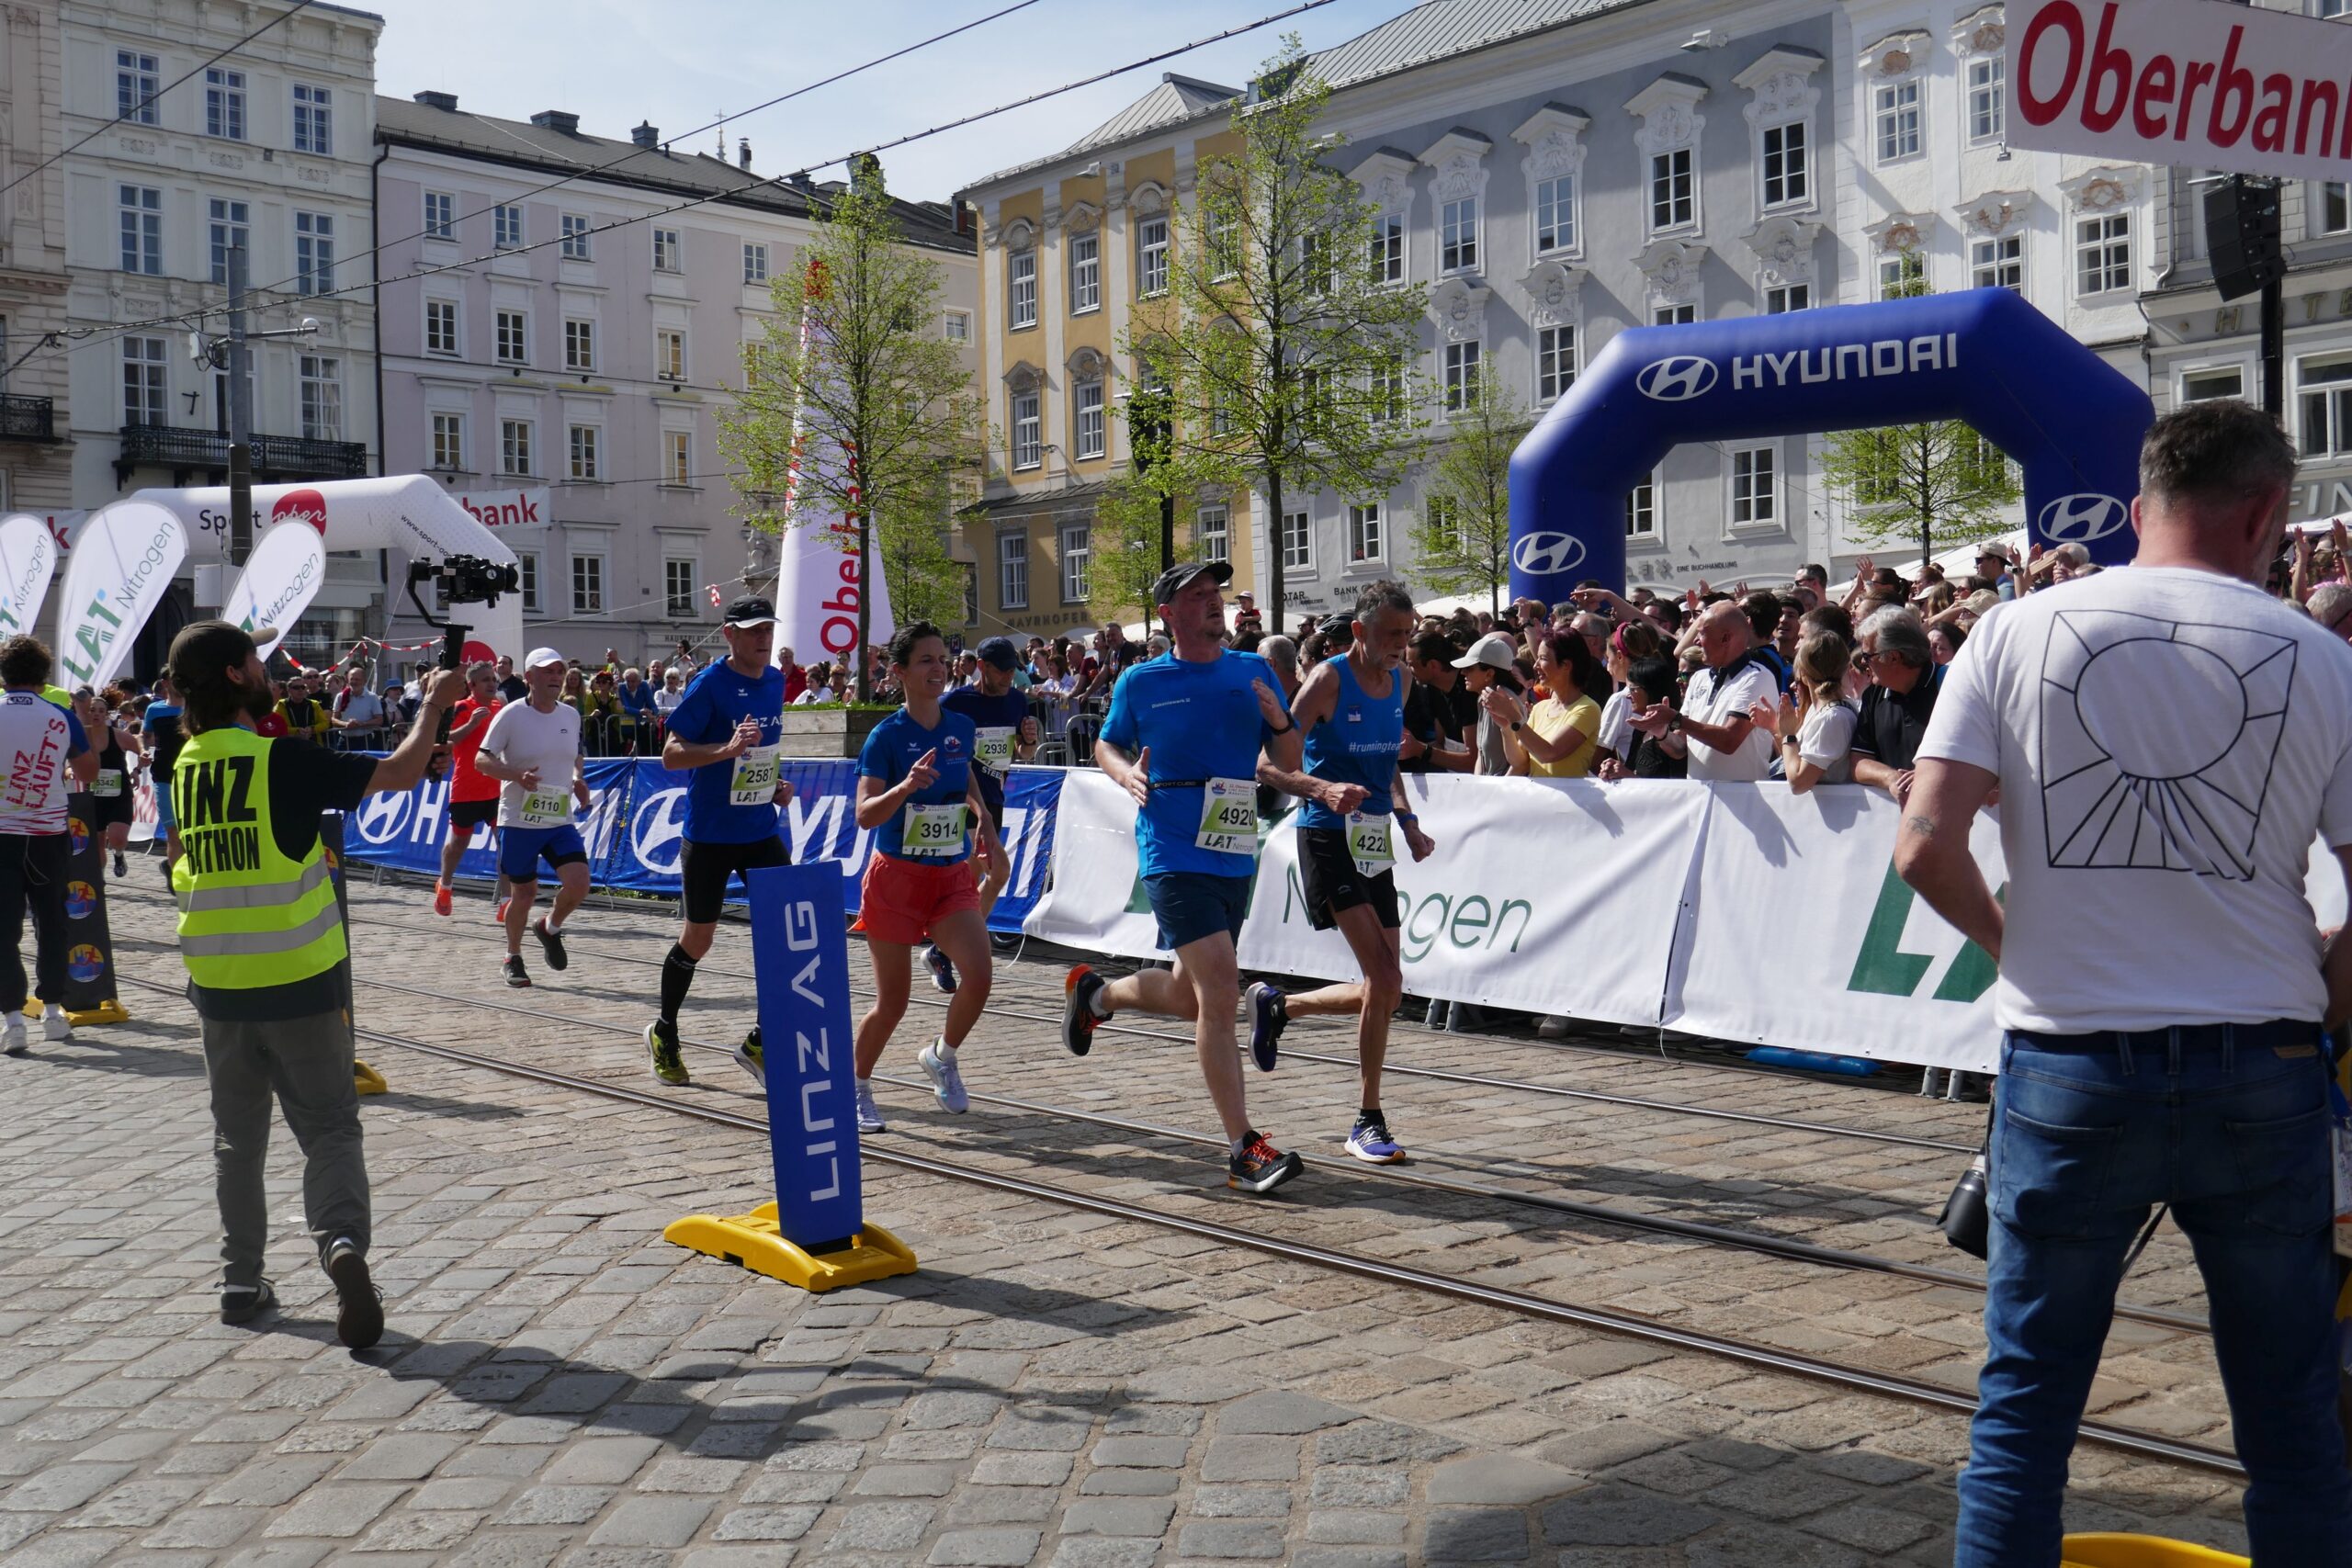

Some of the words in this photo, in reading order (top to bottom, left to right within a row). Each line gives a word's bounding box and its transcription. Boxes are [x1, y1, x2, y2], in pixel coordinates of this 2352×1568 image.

[2017, 0, 2352, 160] Oberban
[1733, 333, 1958, 390] HYUNDAI
[199, 509, 263, 536] Spt
[15, 534, 48, 612] Nitrogen
[116, 521, 175, 610] Nitrogen
[1677, 565, 1690, 573] EINE
[1690, 560, 1738, 572] BUCHHANDLUNG
[260, 552, 320, 628] Nitrogen
[1334, 585, 1359, 596] BANK
[1007, 611, 1088, 628] MAYRHOFER
[984, 743, 1008, 754] 2938
[6, 750, 35, 806] LINZ
[96, 779, 115, 787] 5342
[746, 767, 774, 784] 2587
[533, 798, 560, 813] 6110
[1218, 807, 1254, 826] 4920
[921, 822, 958, 839] 3914
[785, 900, 825, 1009] AG
[797, 1027, 840, 1201] LINZ
